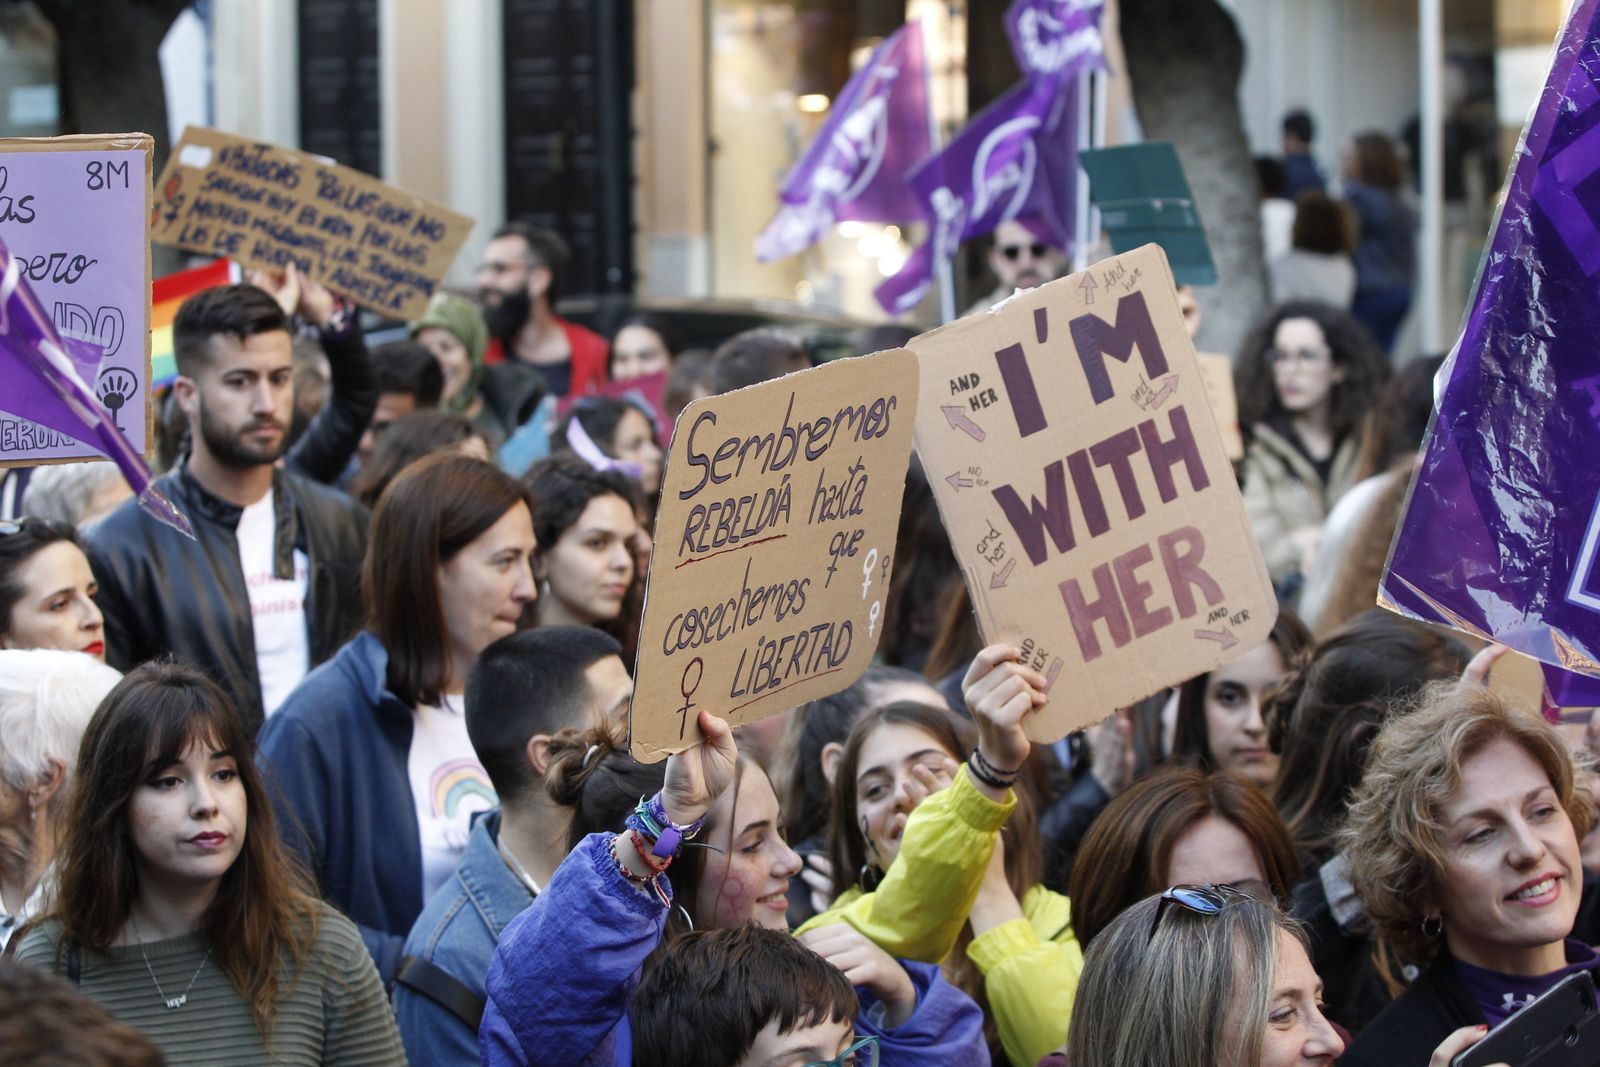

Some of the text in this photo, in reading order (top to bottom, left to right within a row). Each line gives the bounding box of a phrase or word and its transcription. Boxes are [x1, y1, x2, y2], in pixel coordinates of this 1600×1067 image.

[86, 160, 129, 190] 8M
[994, 290, 1169, 438] I'M
[949, 372, 981, 397] AND
[968, 387, 999, 412] HER
[679, 391, 897, 500] Sembremos
[990, 404, 1211, 567] WITH
[679, 456, 868, 558] REBELDÍA hasta
[976, 518, 1002, 555] and
[984, 540, 1007, 567] her
[825, 527, 865, 588] que
[663, 557, 811, 656] cosechemos
[1057, 525, 1226, 663] HER
[1207, 606, 1228, 625] AND
[1229, 608, 1250, 627] HER
[1015, 638, 1035, 666] AND
